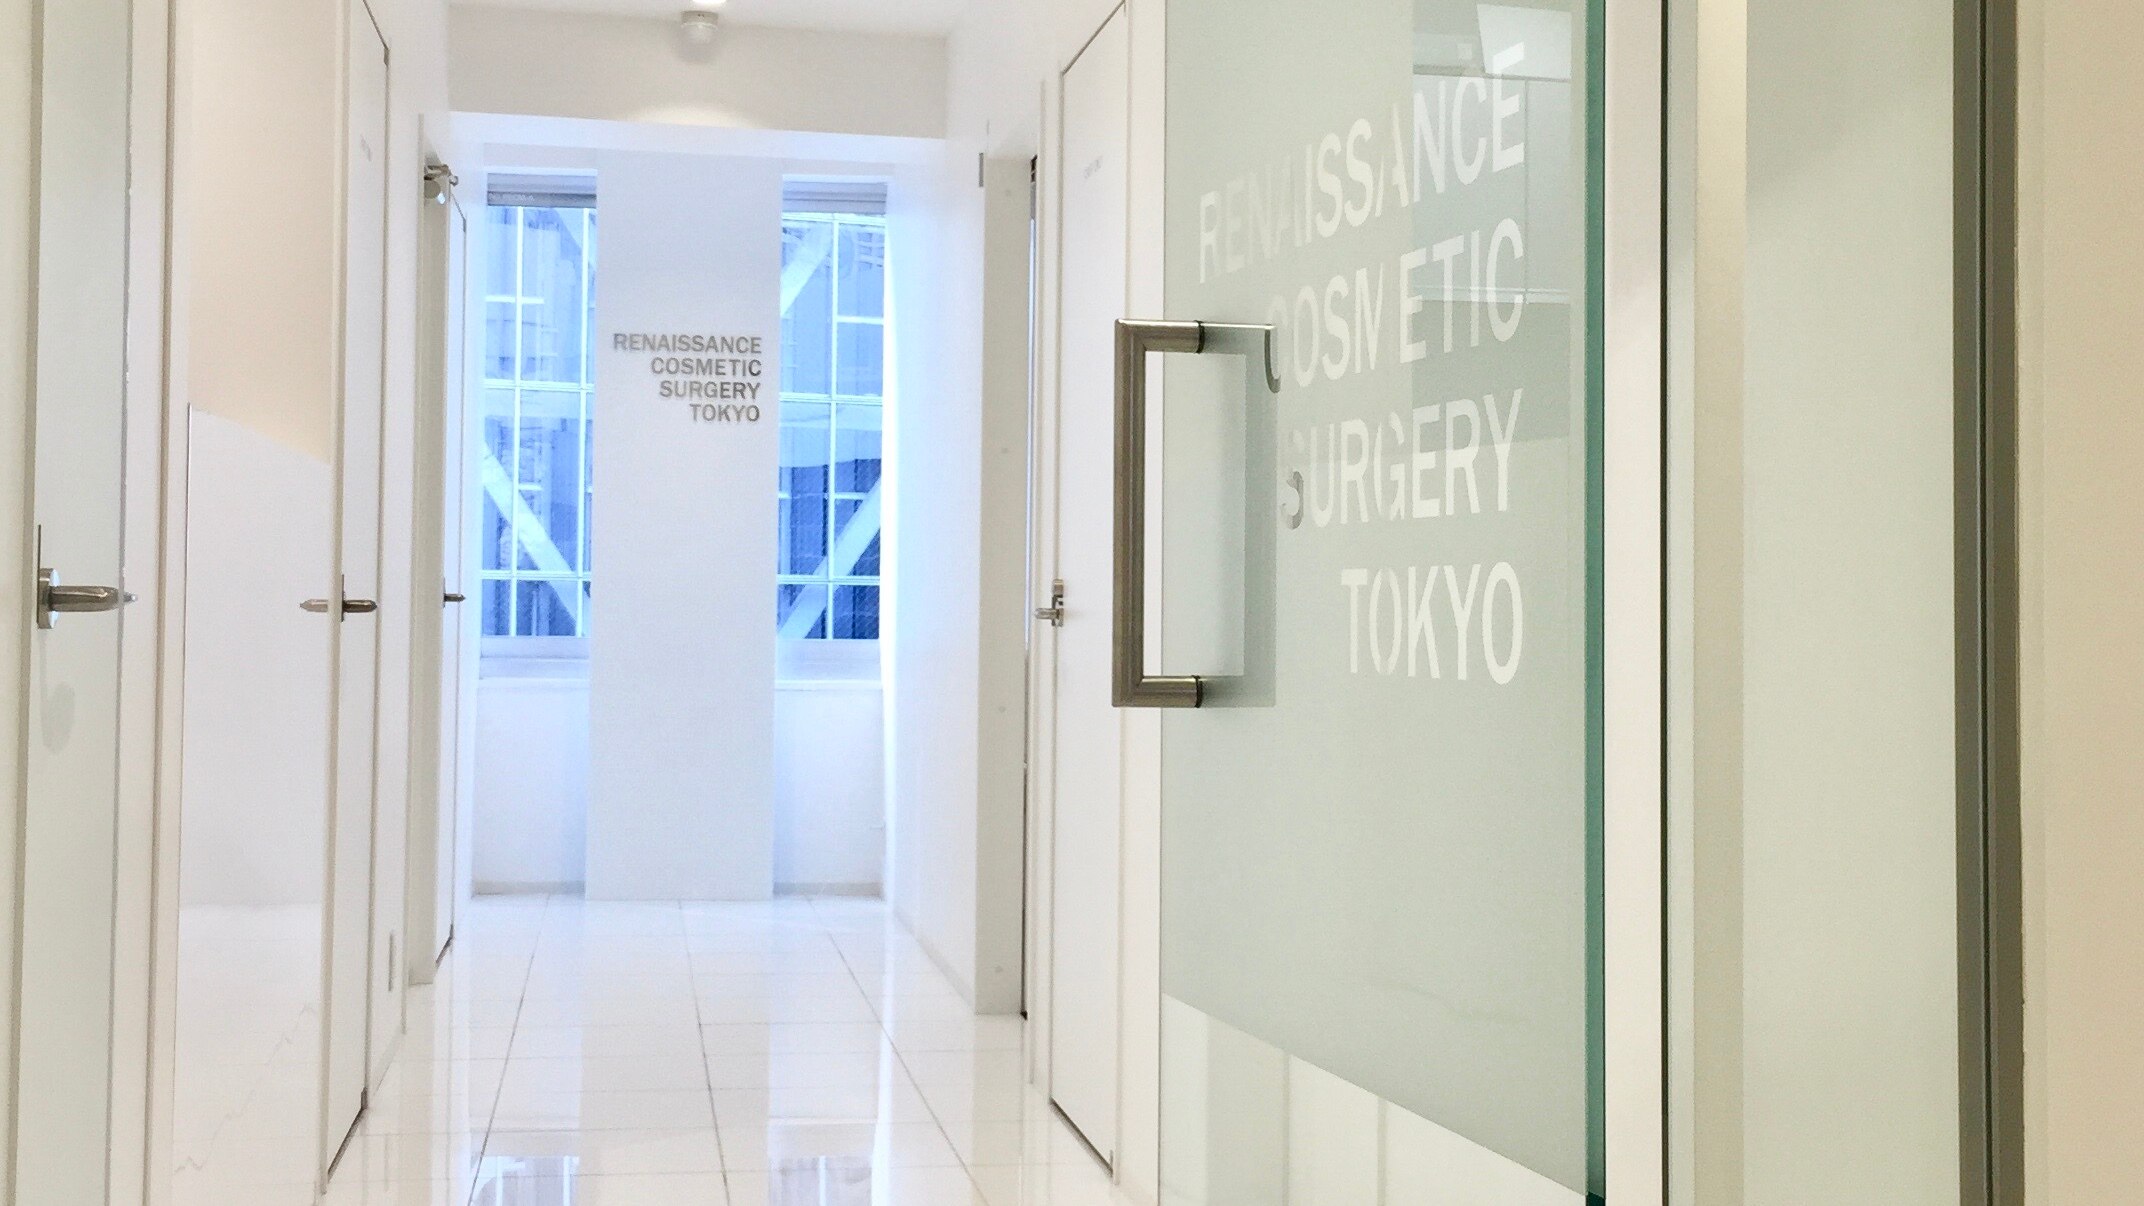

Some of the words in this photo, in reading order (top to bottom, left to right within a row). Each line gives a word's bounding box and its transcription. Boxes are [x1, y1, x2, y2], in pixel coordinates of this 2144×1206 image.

[1200, 42, 1525, 284] RENAISSANCE
[613, 333, 762, 354] RENAISSANCE
[651, 356, 762, 377] COSMETIC
[659, 380, 761, 400] SURGERY
[689, 403, 760, 423] TOKYO
[1281, 388, 1524, 530] SURGERY
[1341, 561, 1524, 685] TOKYO
